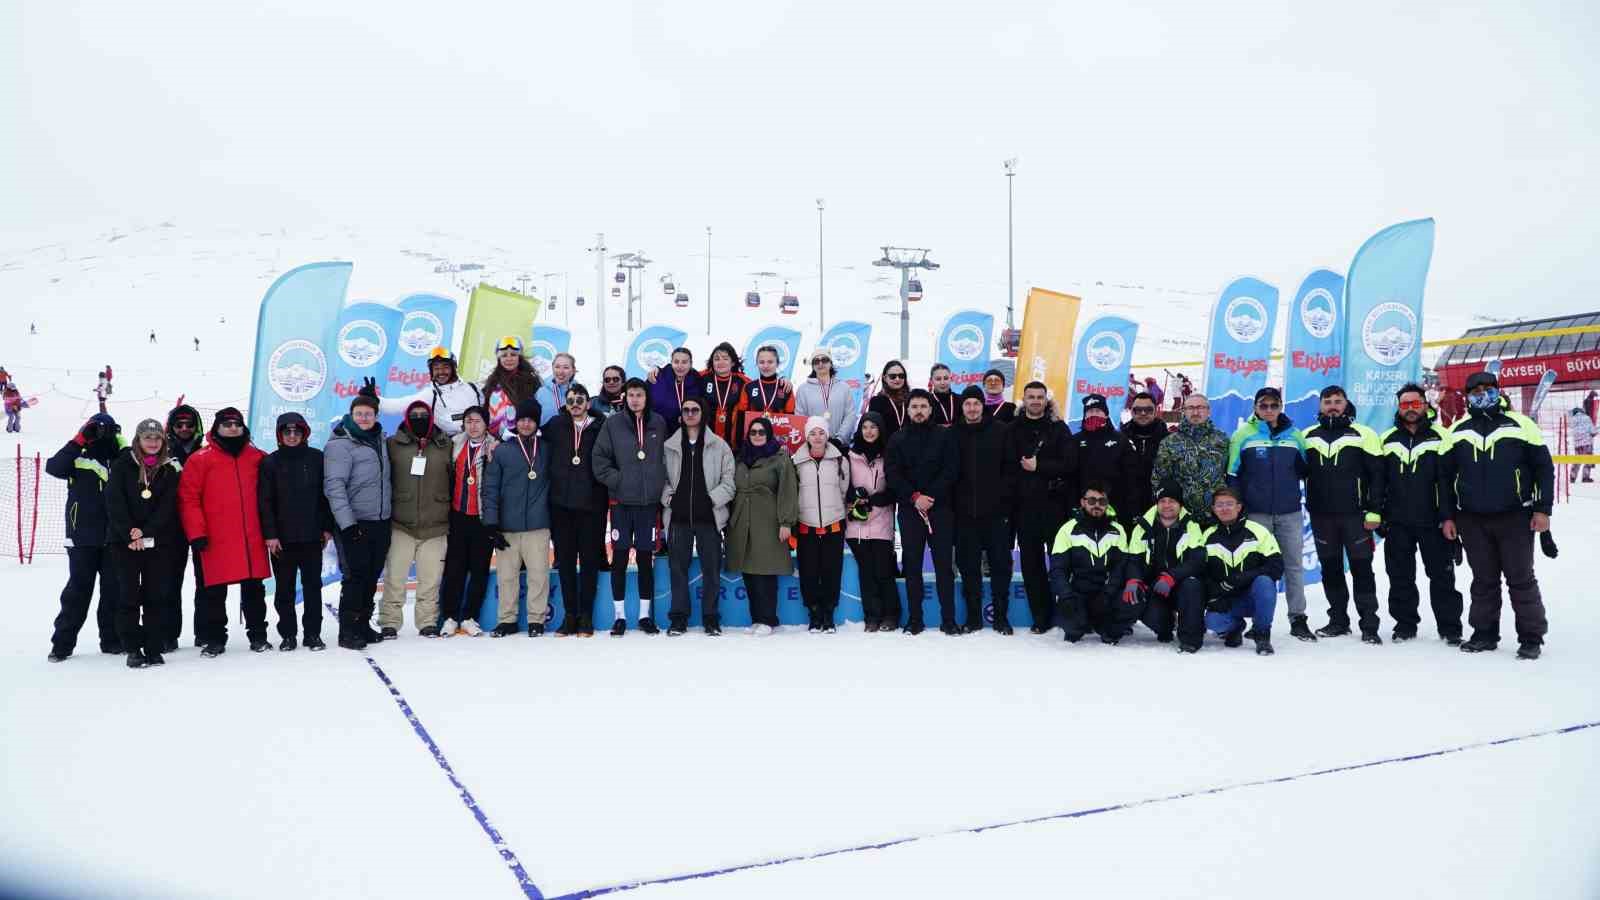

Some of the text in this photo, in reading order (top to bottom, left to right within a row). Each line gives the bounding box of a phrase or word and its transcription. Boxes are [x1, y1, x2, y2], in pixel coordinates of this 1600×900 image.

[1214, 352, 1268, 377] Erciyes
[1291, 351, 1341, 376] Erciyes
[706, 382, 713, 393] 8
[751, 388, 759, 397] 6
[1076, 379, 1126, 398] Erciyes
